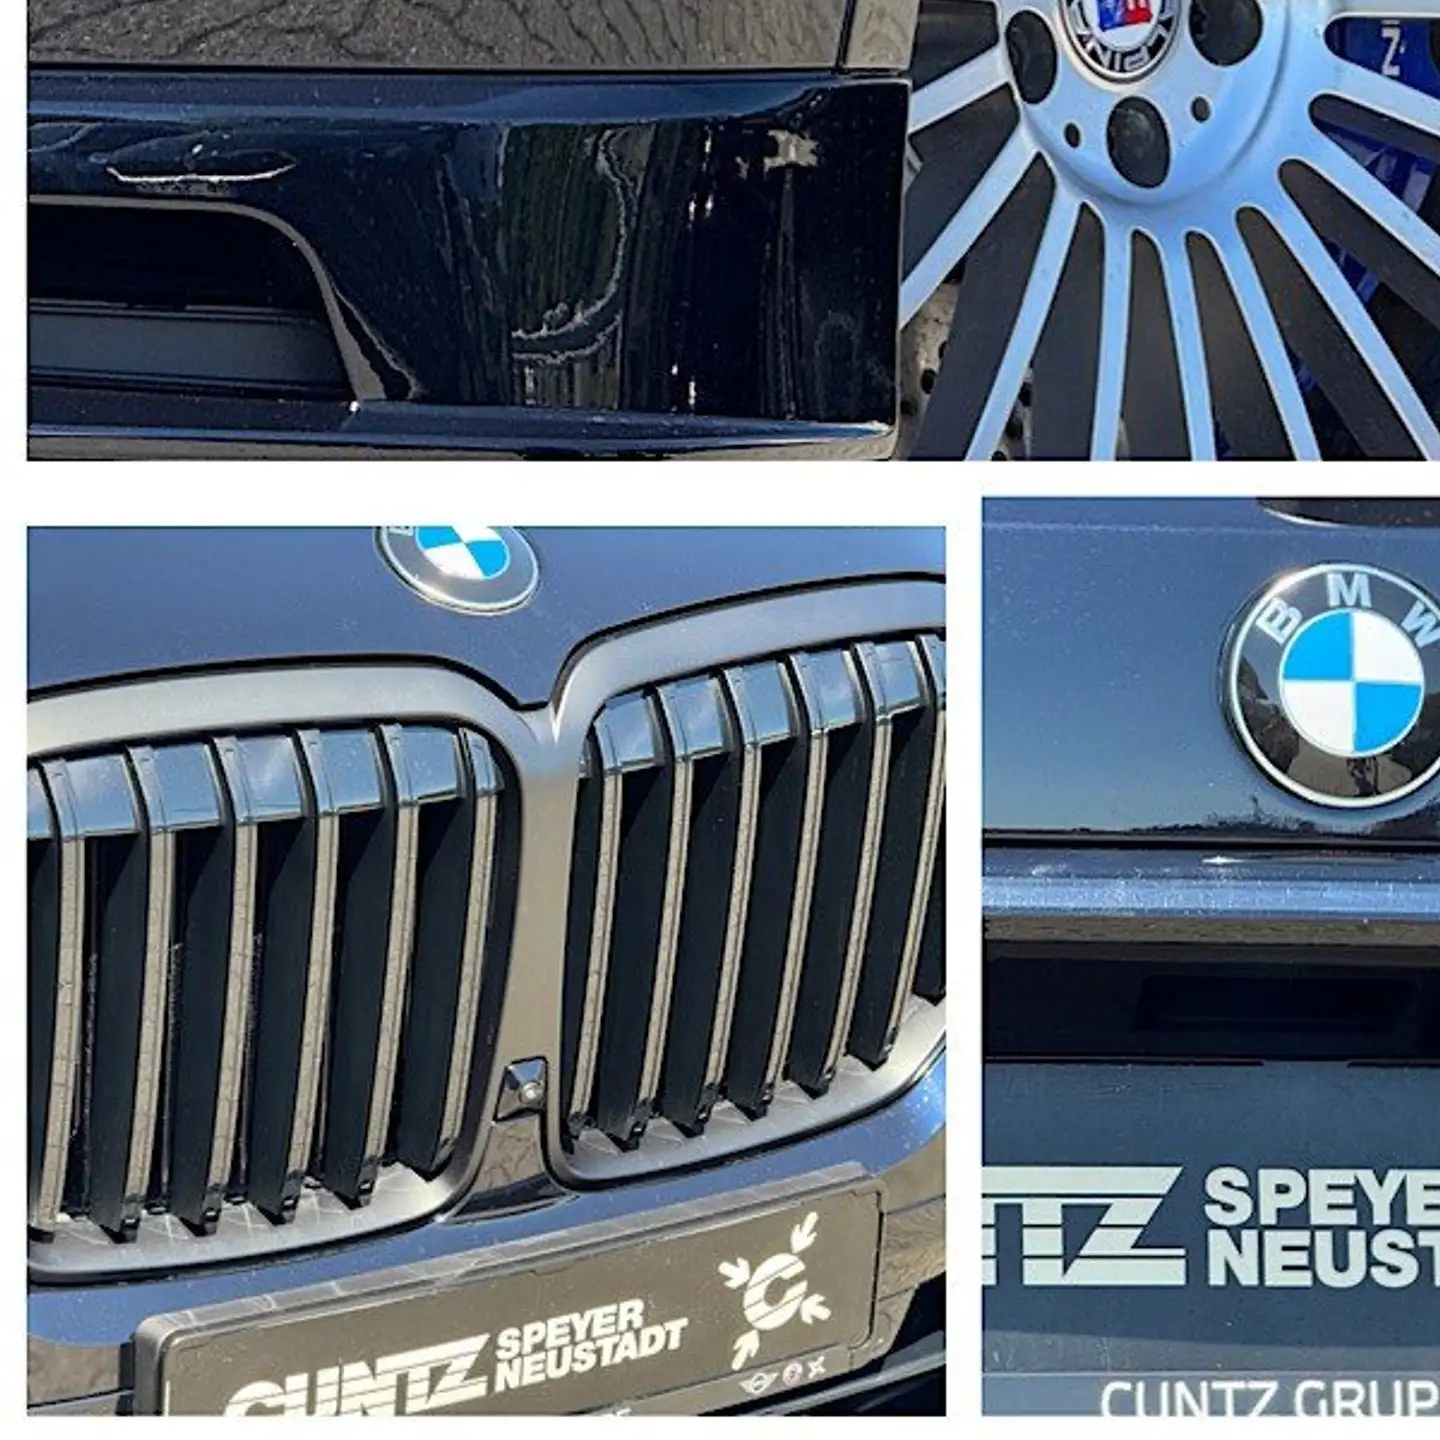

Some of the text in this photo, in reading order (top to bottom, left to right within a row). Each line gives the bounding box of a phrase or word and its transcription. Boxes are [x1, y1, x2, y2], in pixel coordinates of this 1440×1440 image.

[494, 1317, 689, 1394] NEUSTADT
[496, 1298, 645, 1360] SPEYER
[1100, 1380, 1279, 1417] CUNTZ
